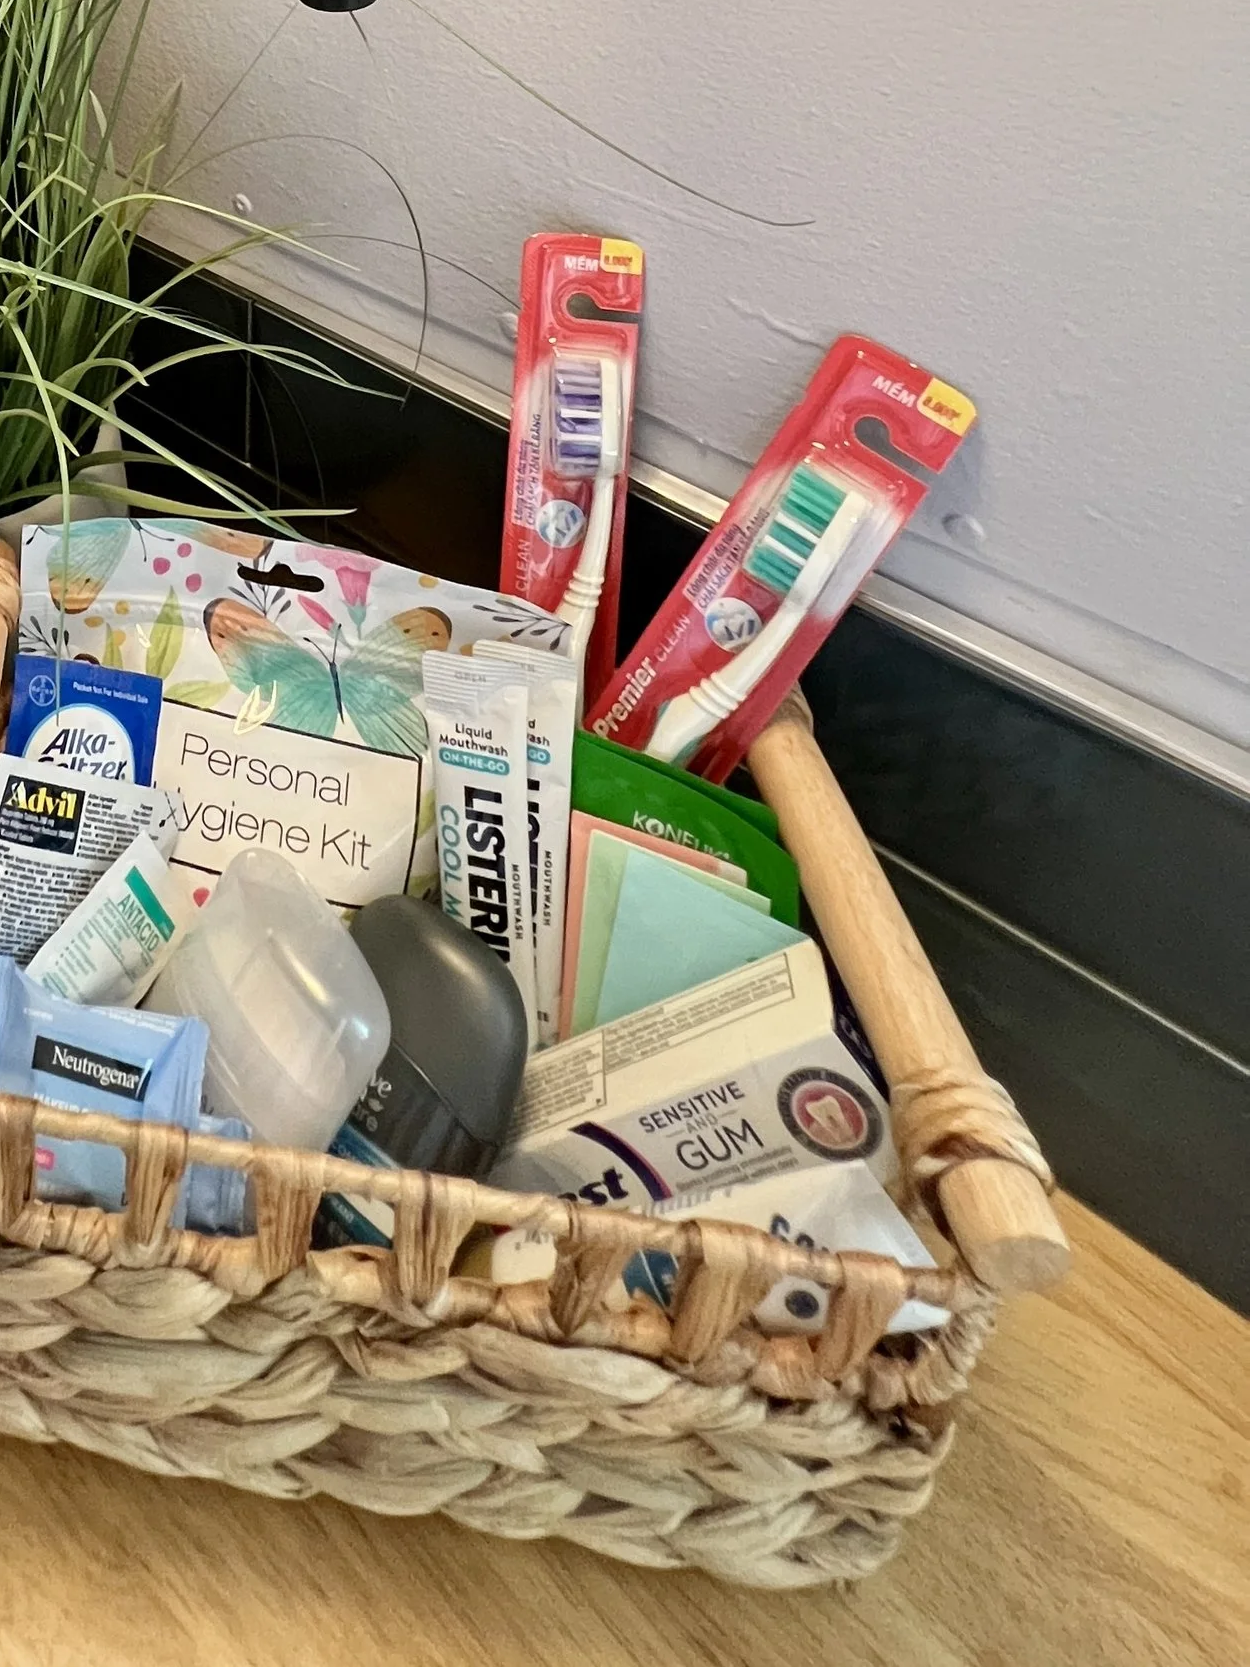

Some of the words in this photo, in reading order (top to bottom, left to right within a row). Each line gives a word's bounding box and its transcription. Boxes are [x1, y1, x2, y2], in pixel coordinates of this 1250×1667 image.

[592, 656, 657, 739] Premier
[654, 614, 691, 663] CLEAN
[41, 728, 117, 756] Alka-
[439, 733, 508, 757] Mouthwash
[455, 722, 492, 740] Liquid
[180, 732, 350, 807] Personal
[442, 750, 506, 772] ON-THE-GO
[4, 780, 78, 820] Advil
[153, 781, 310, 854] ygiene
[320, 822, 372, 871] Kit
[439, 804, 462, 883] COOL
[511, 863, 524, 941] MOUTHWASH
[543, 850, 554, 927] MOUTHWASH
[117, 894, 160, 953] ANTACID
[52, 1045, 140, 1089] Neutrogena
[639, 1080, 746, 1134] SENSITIVE
[685, 1114, 719, 1135] AND
[675, 1118, 765, 1171] GUM
